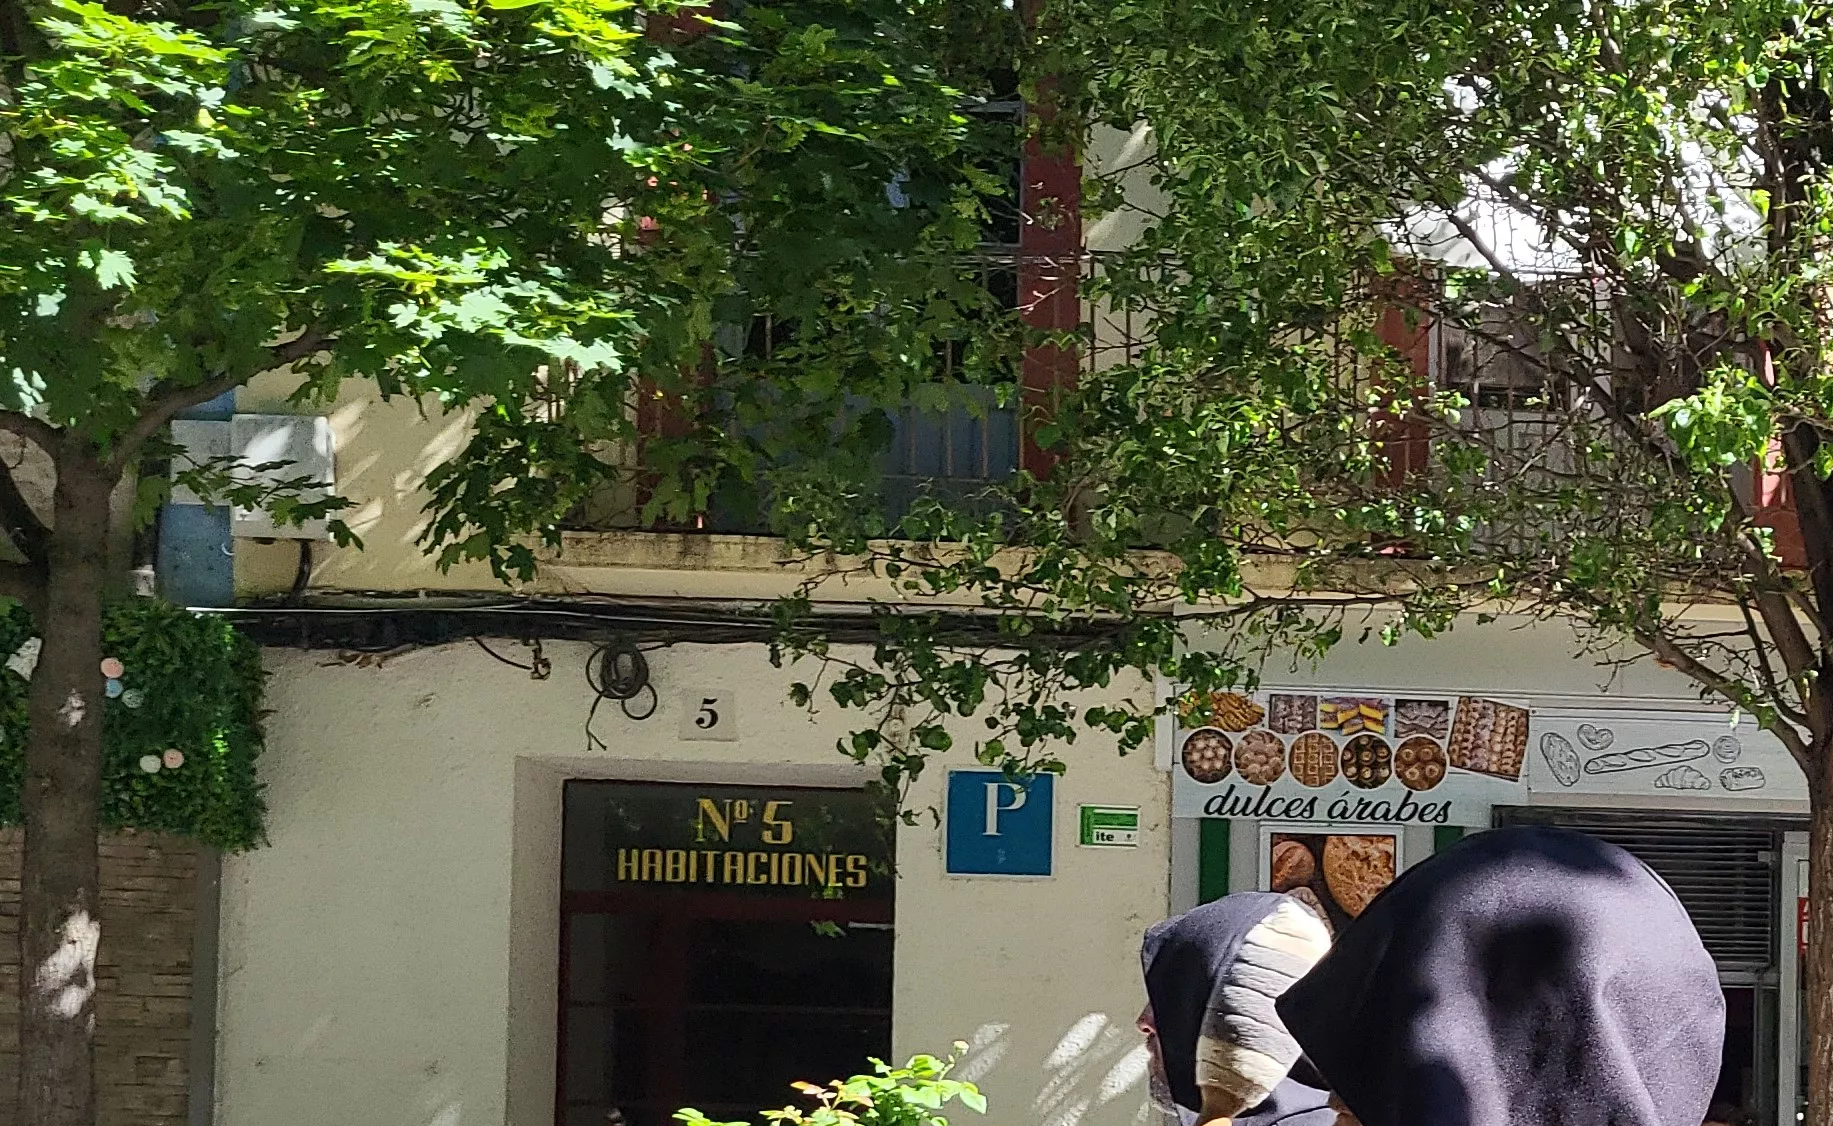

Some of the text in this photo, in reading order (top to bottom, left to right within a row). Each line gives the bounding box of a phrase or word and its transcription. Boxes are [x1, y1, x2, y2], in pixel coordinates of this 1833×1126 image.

[695, 698, 719, 729] 5
[761, 800, 794, 845] 5
[982, 782, 1027, 836] P
[1203, 785, 1453, 824] dulces árabes
[1095, 830, 1115, 842] ite
[617, 848, 868, 888] HABITACIONES
